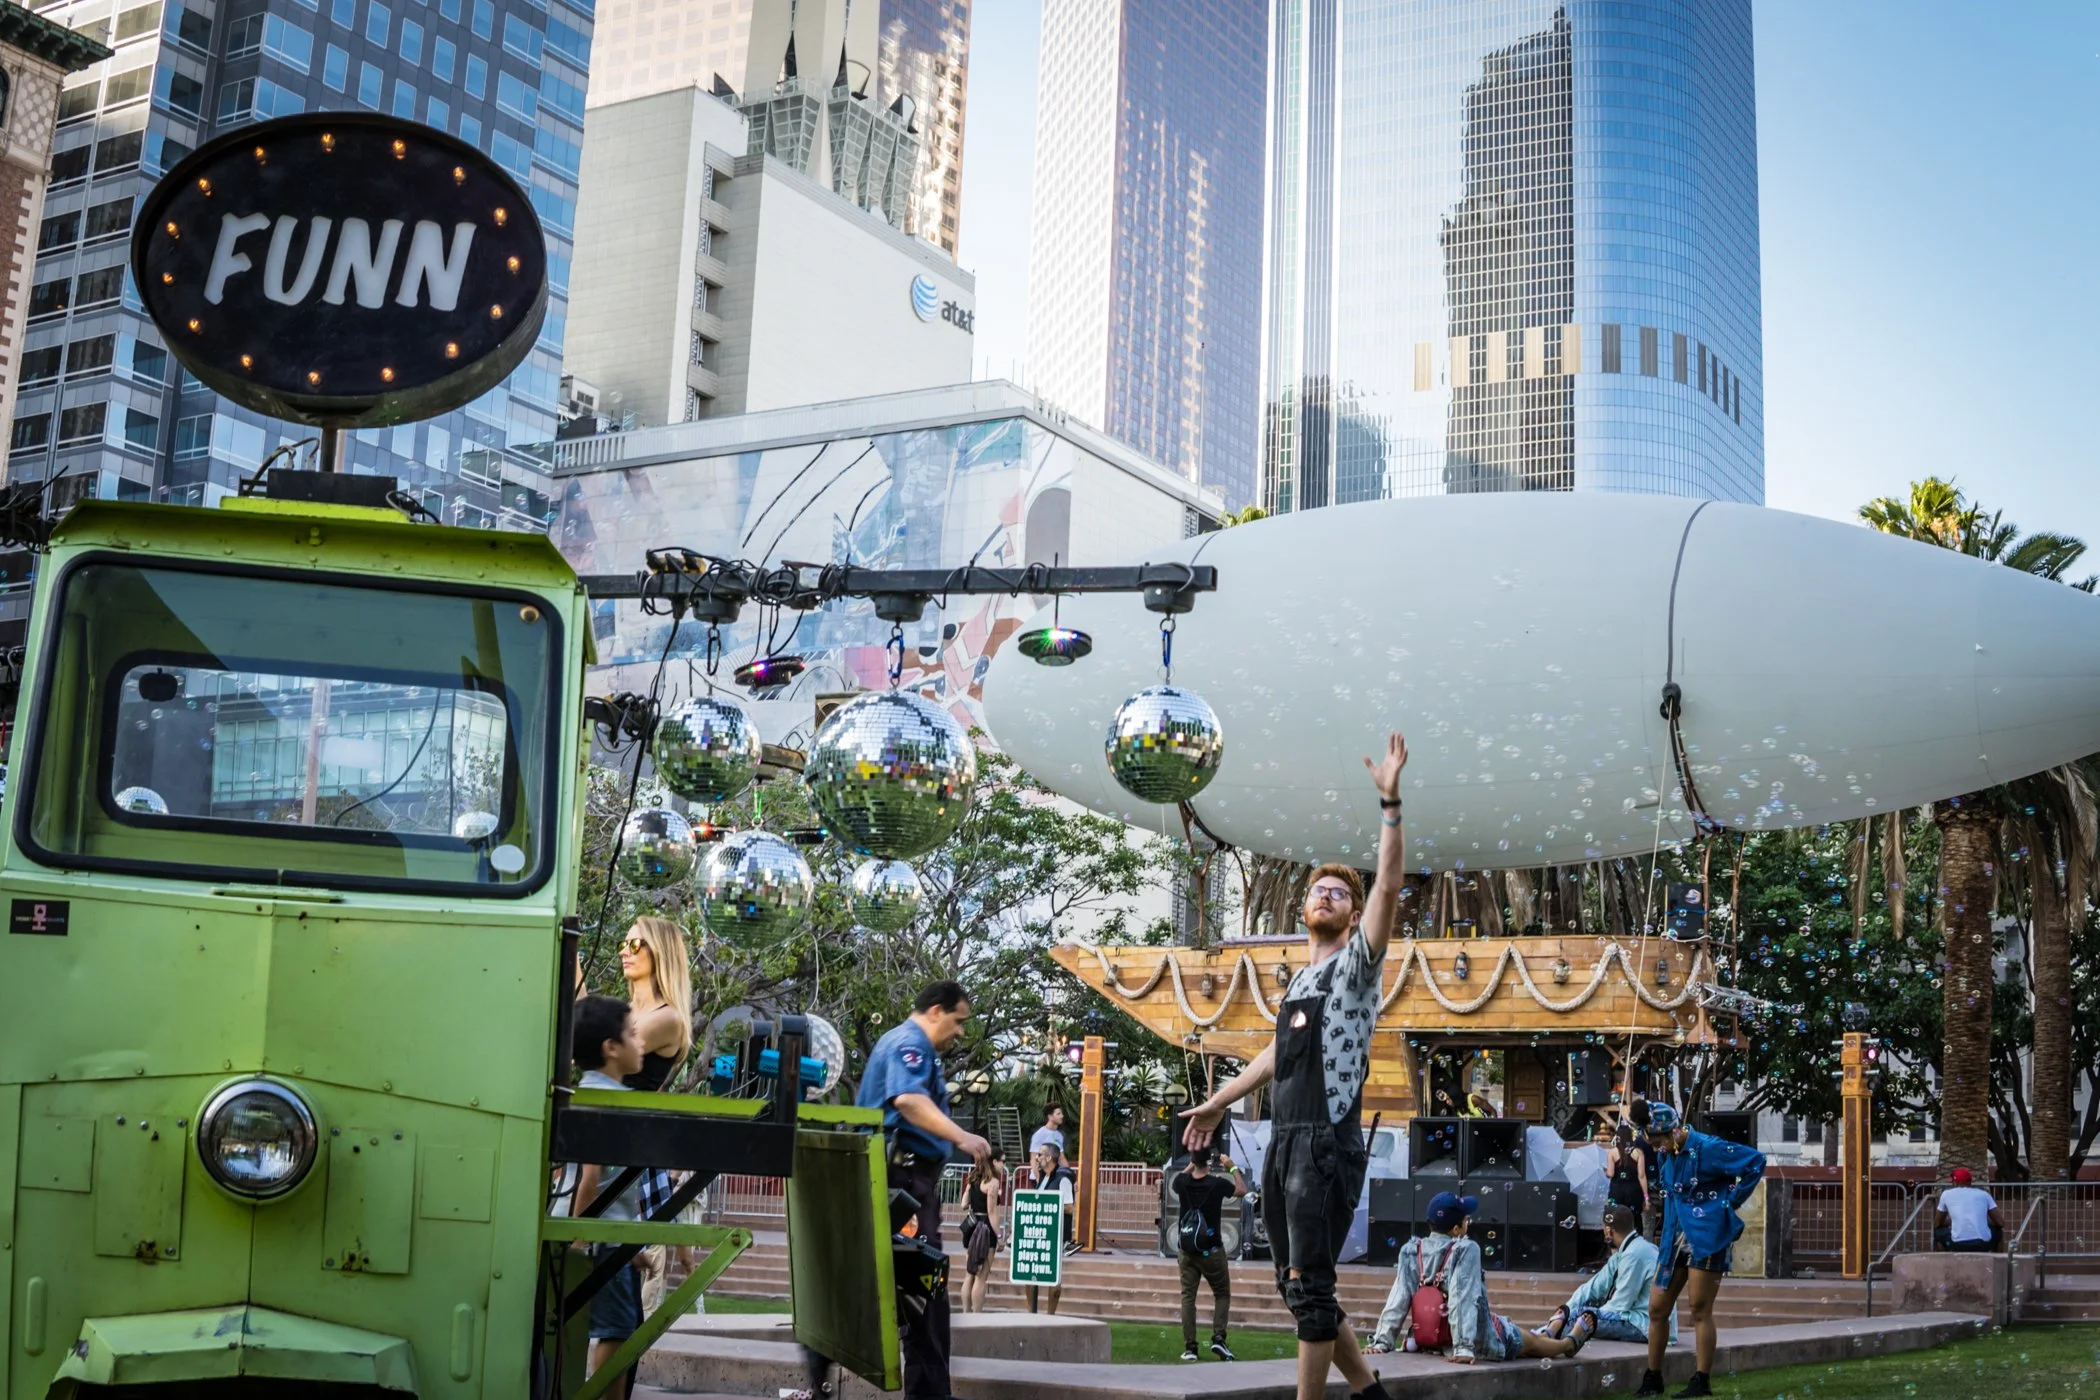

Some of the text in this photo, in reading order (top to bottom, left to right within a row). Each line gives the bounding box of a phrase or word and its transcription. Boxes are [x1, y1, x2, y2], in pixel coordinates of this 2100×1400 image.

[203, 212, 477, 311] FUNN
[941, 300, 975, 335] at&t
[1016, 1200, 1058, 1213] Please use
[1020, 1214, 1052, 1225] pet area
[1023, 1225, 1047, 1237] before
[1018, 1238, 1051, 1251] your dog
[1018, 1250, 1051, 1262] plays on
[1017, 1262, 1052, 1274] the lawn.
